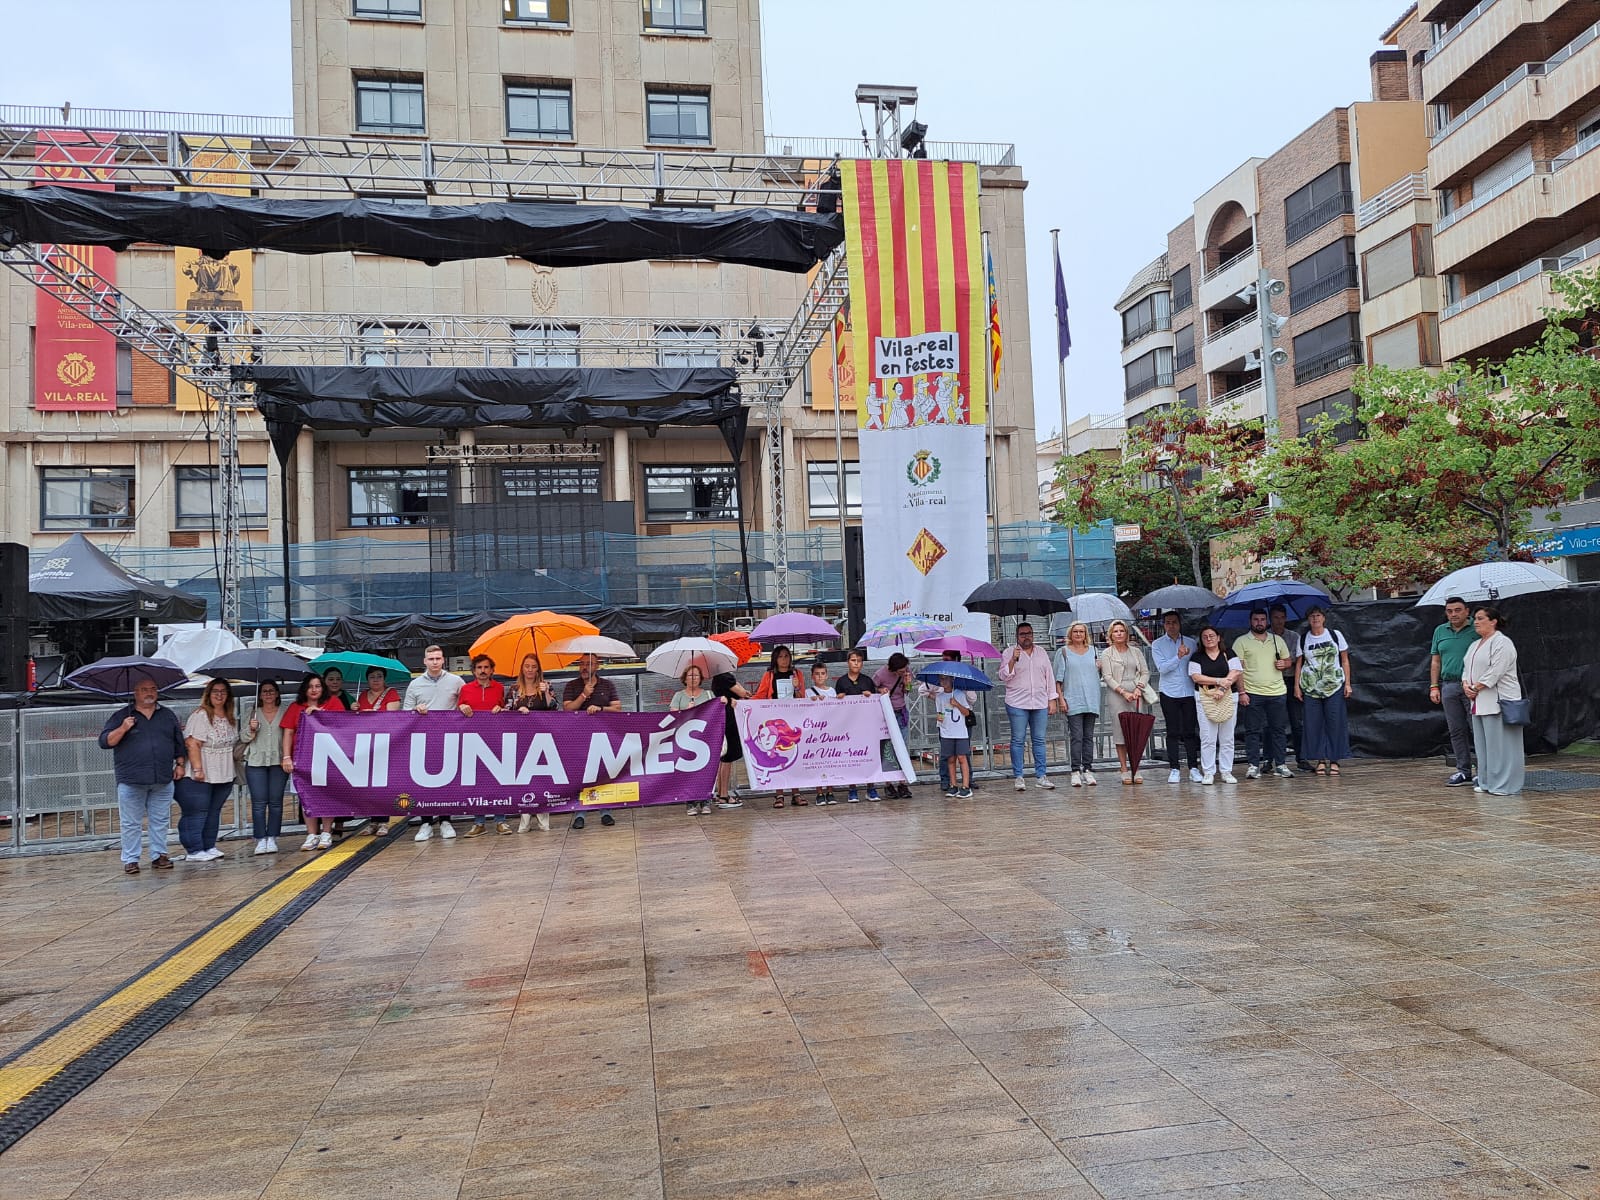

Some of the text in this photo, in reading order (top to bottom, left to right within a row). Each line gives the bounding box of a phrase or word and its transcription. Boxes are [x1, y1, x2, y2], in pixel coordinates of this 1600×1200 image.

[58, 320, 95, 329] Vila-real
[880, 334, 954, 358] Vila-real
[881, 353, 955, 375] en festes
[43, 391, 109, 402] VILA-REAL
[909, 495, 947, 508] Vila-real
[802, 717, 828, 731] Grup
[805, 731, 850, 744] de Dones
[311, 714, 711, 789] NI UNA MÉS
[802, 749, 815, 760] de
[416, 801, 461, 809] Ajuntament
[467, 796, 513, 807] Vila-real
